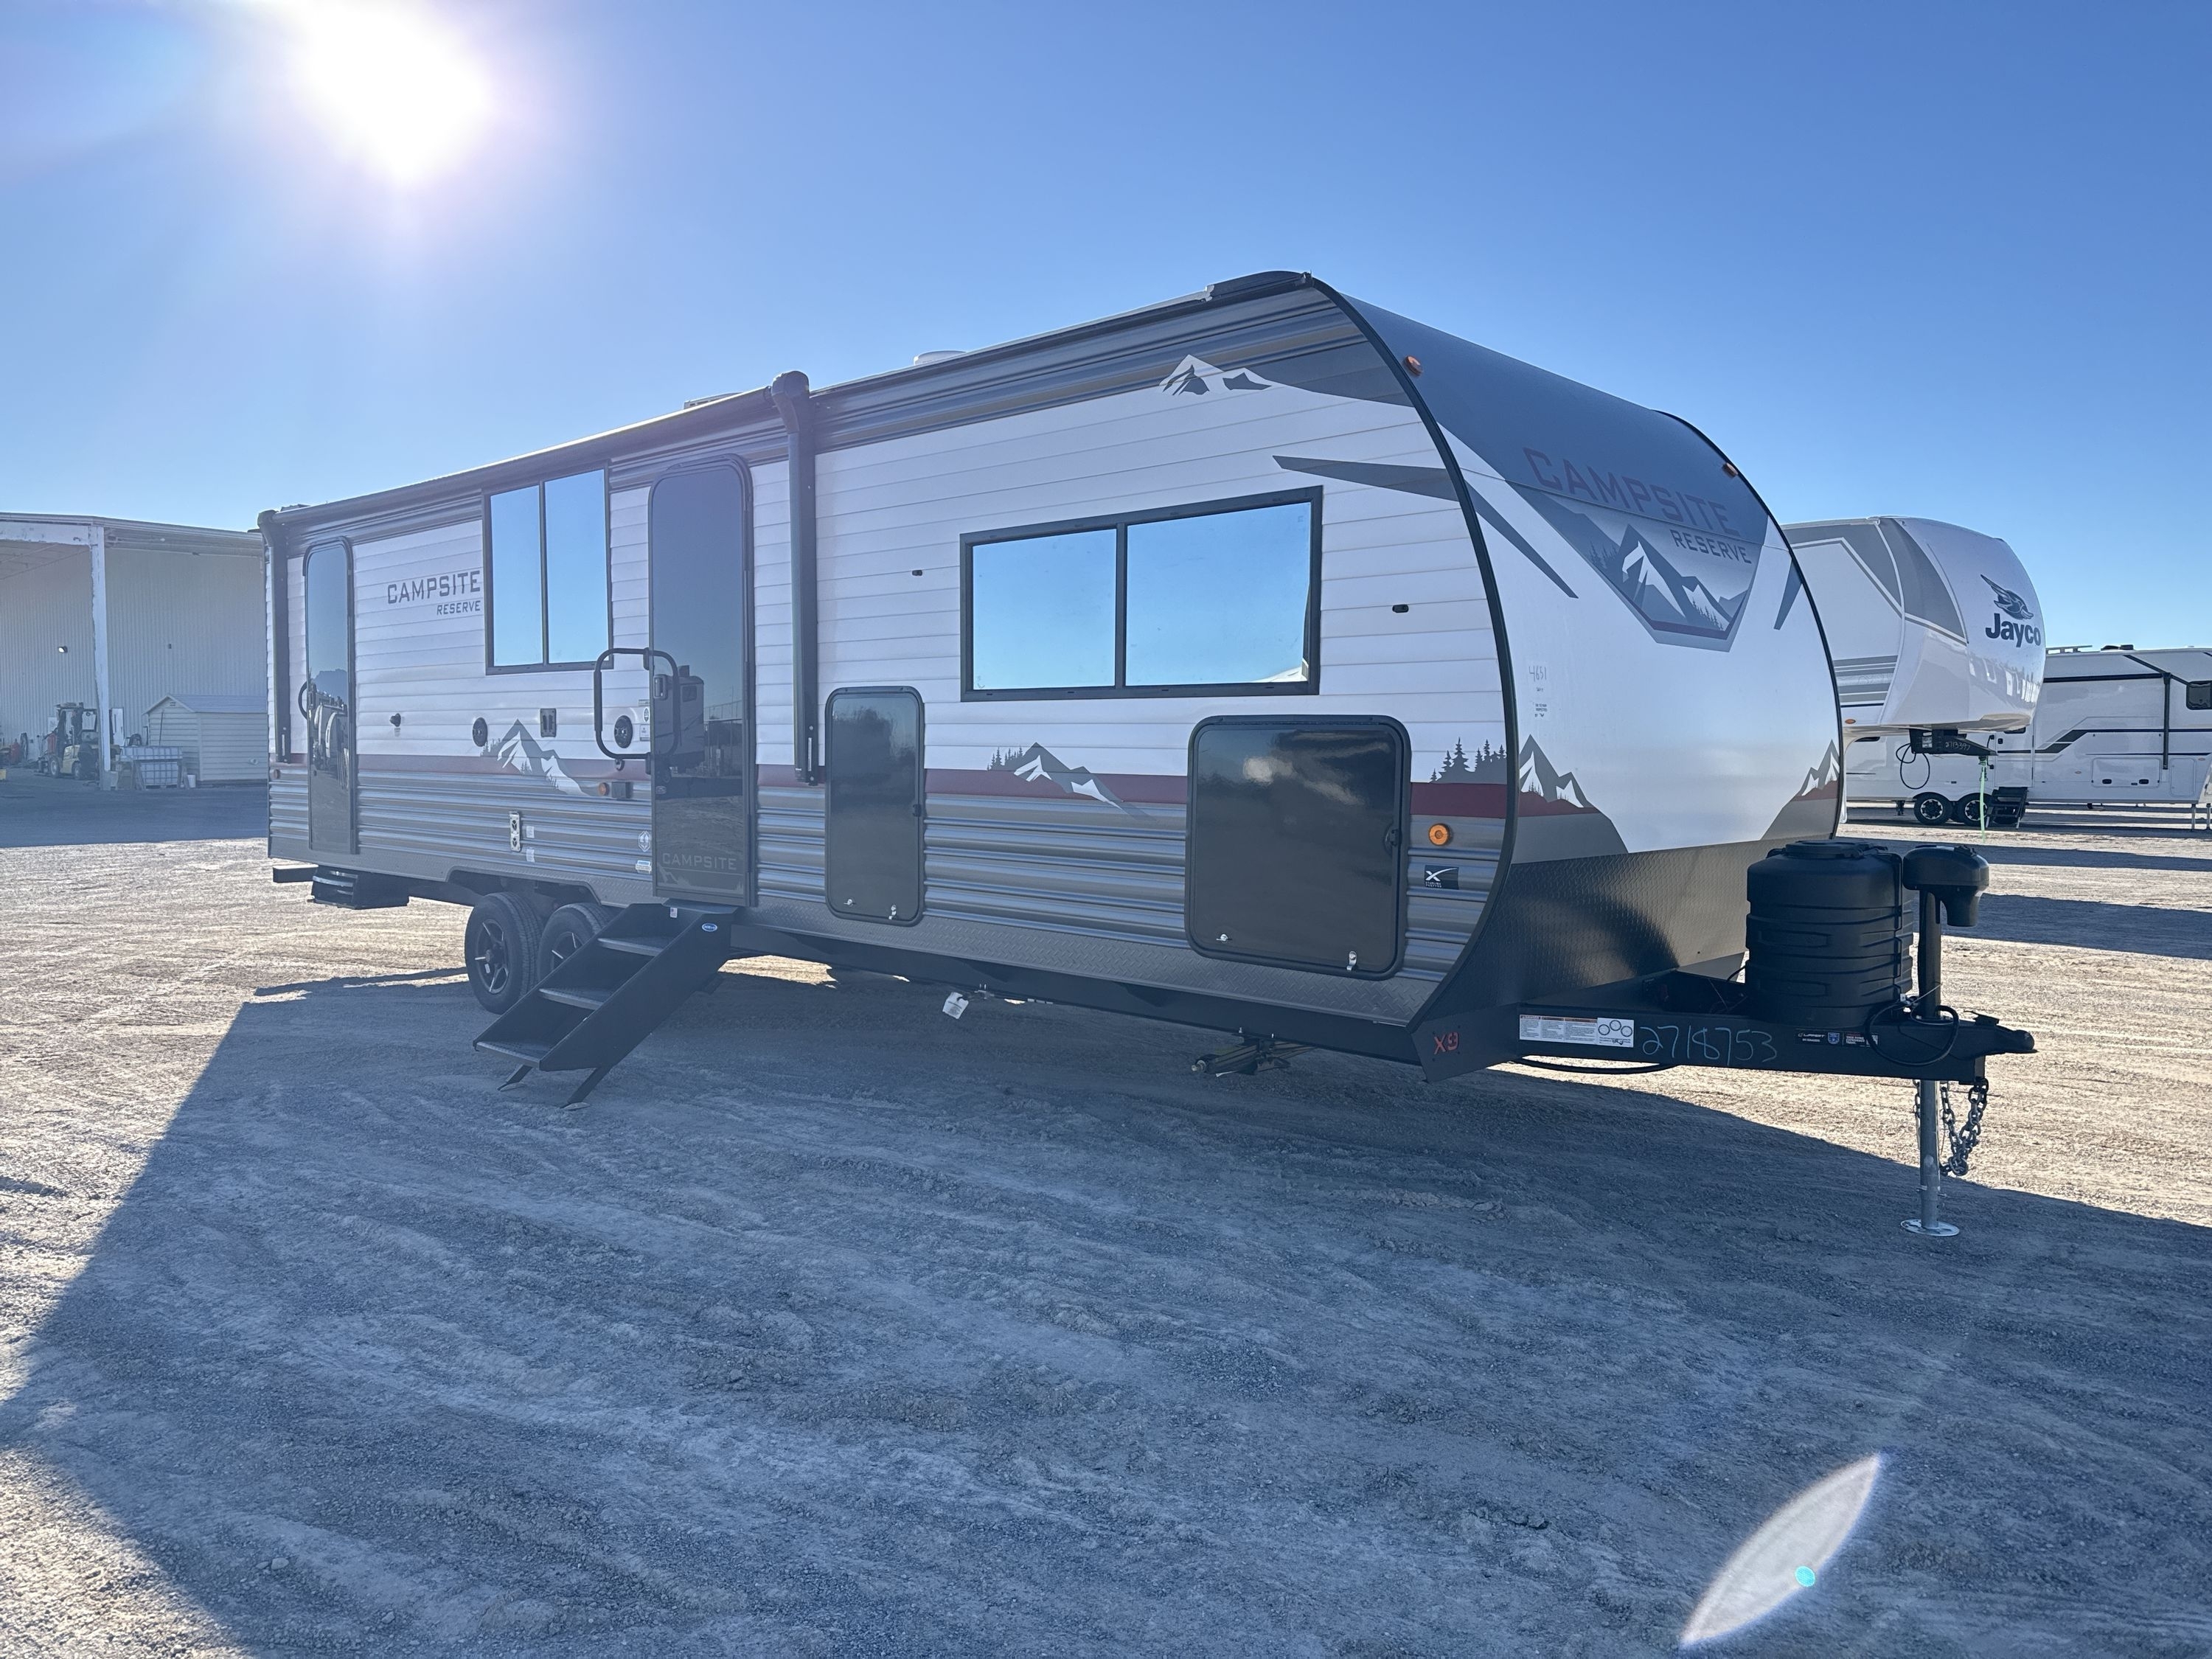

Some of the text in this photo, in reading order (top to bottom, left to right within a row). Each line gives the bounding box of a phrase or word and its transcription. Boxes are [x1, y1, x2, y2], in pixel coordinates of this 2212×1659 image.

[1523, 446, 1740, 537] CAMPSITE
[1669, 529, 1752, 564] RESERVE
[387, 570, 481, 604] CAMPSITE
[437, 600, 481, 616] RESERVE
[1985, 613, 2041, 648] Jayco
[1528, 665, 1547, 682] 4651
[662, 853, 737, 870] CAMPSITE
[1639, 1024, 1778, 1066] 2718753
